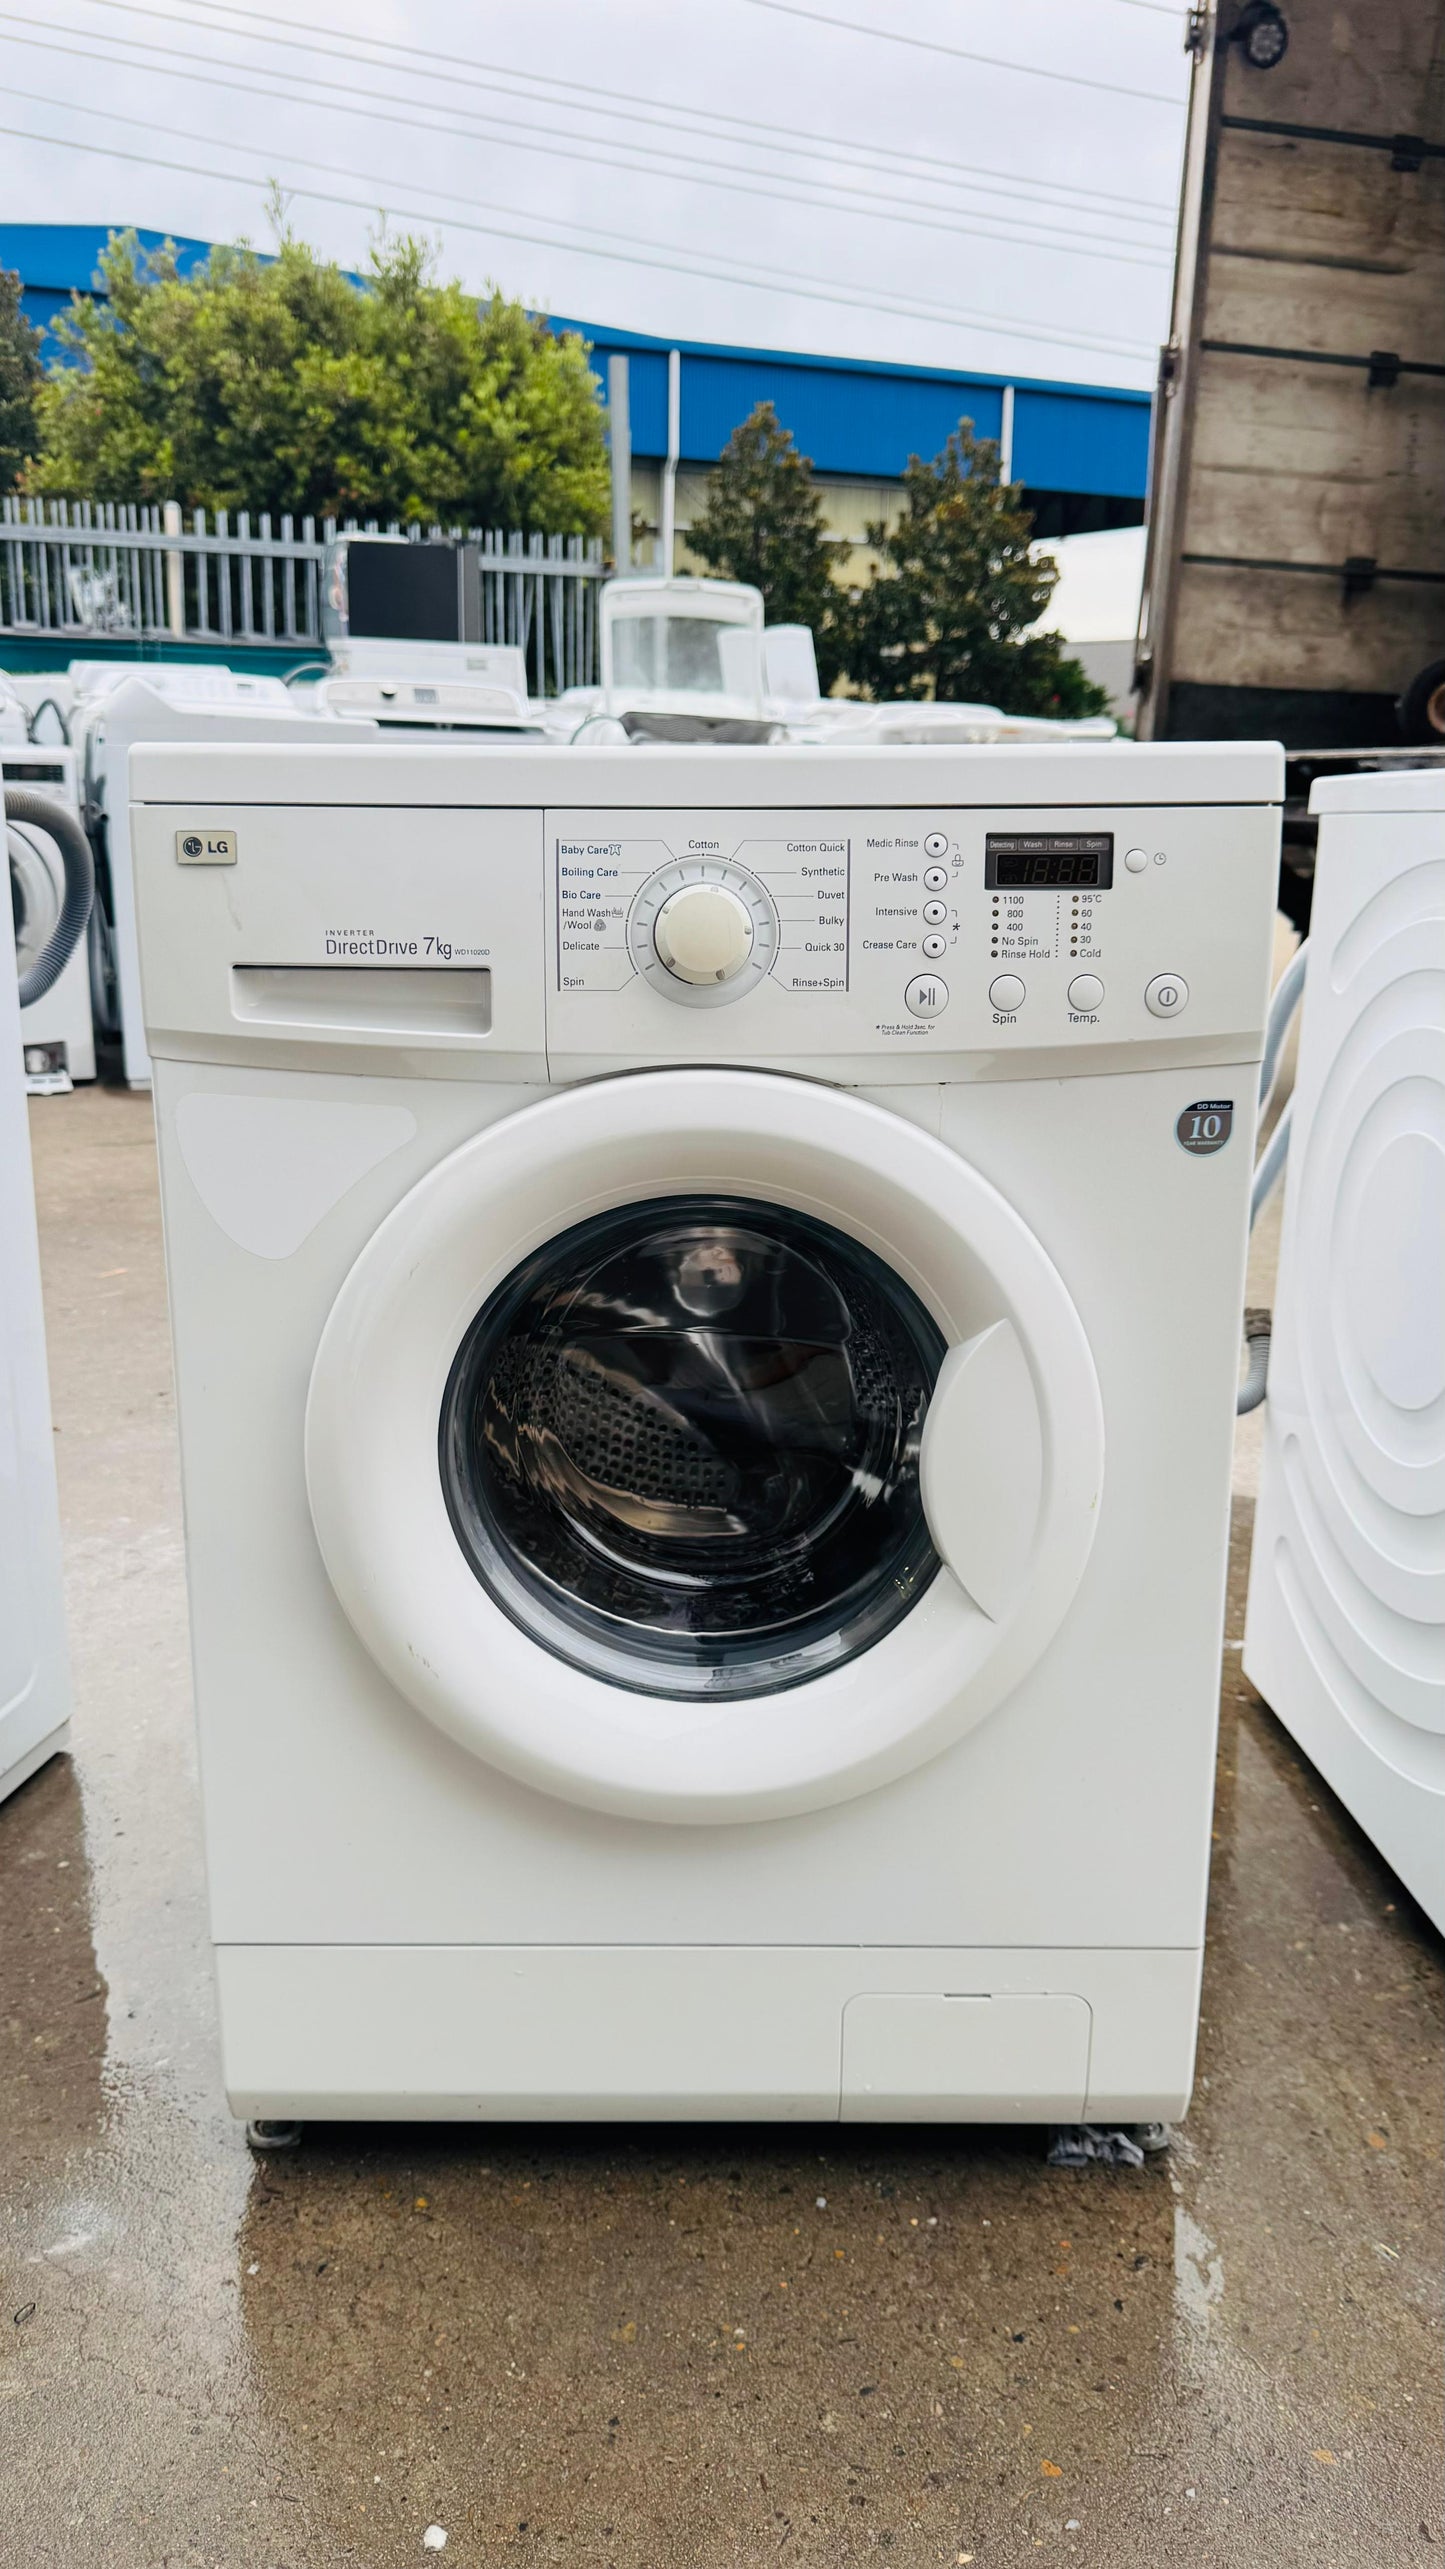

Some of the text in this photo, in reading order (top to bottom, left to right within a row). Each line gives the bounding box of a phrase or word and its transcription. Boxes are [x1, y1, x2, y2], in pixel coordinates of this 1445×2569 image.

[207, 841, 228, 854] LG
[688, 840, 719, 849] Cotton
[787, 843, 845, 852] Cotton Quick
[867, 839, 919, 848] Medic Rinse
[990, 841, 1014, 849] Detecting
[561, 846, 608, 856] Baby Care
[562, 868, 618, 878] Boiling Care
[801, 867, 845, 877] Synthetic
[874, 873, 918, 882] Pre Wash
[562, 891, 601, 899] Bio Care
[818, 891, 845, 899] Duvet
[1081, 894, 1102, 903] 95°C
[1003, 896, 1024, 905] 1100
[562, 909, 611, 917] Hand Wash
[876, 907, 917, 916] Intensive
[1007, 909, 1023, 918] 800
[1081, 909, 1092, 917] 60
[563, 921, 592, 930] /Wool
[819, 916, 844, 926] Bulky
[1006, 923, 1023, 931] 400
[1081, 922, 1092, 931] 40
[863, 940, 917, 949] Crease Care
[1002, 936, 1038, 947] No Spin
[1080, 936, 1091, 944] 30
[563, 941, 599, 950] Delicate
[805, 942, 845, 952] Quick 30
[1002, 950, 1050, 959] Rinse Hold
[1080, 949, 1101, 958] Cold
[563, 978, 584, 987] Spin
[792, 978, 844, 988] Rinse+Spin
[992, 1013, 1017, 1025] Spin
[1068, 1013, 1100, 1024] Temp.
[1189, 1115, 1221, 1138] 10
